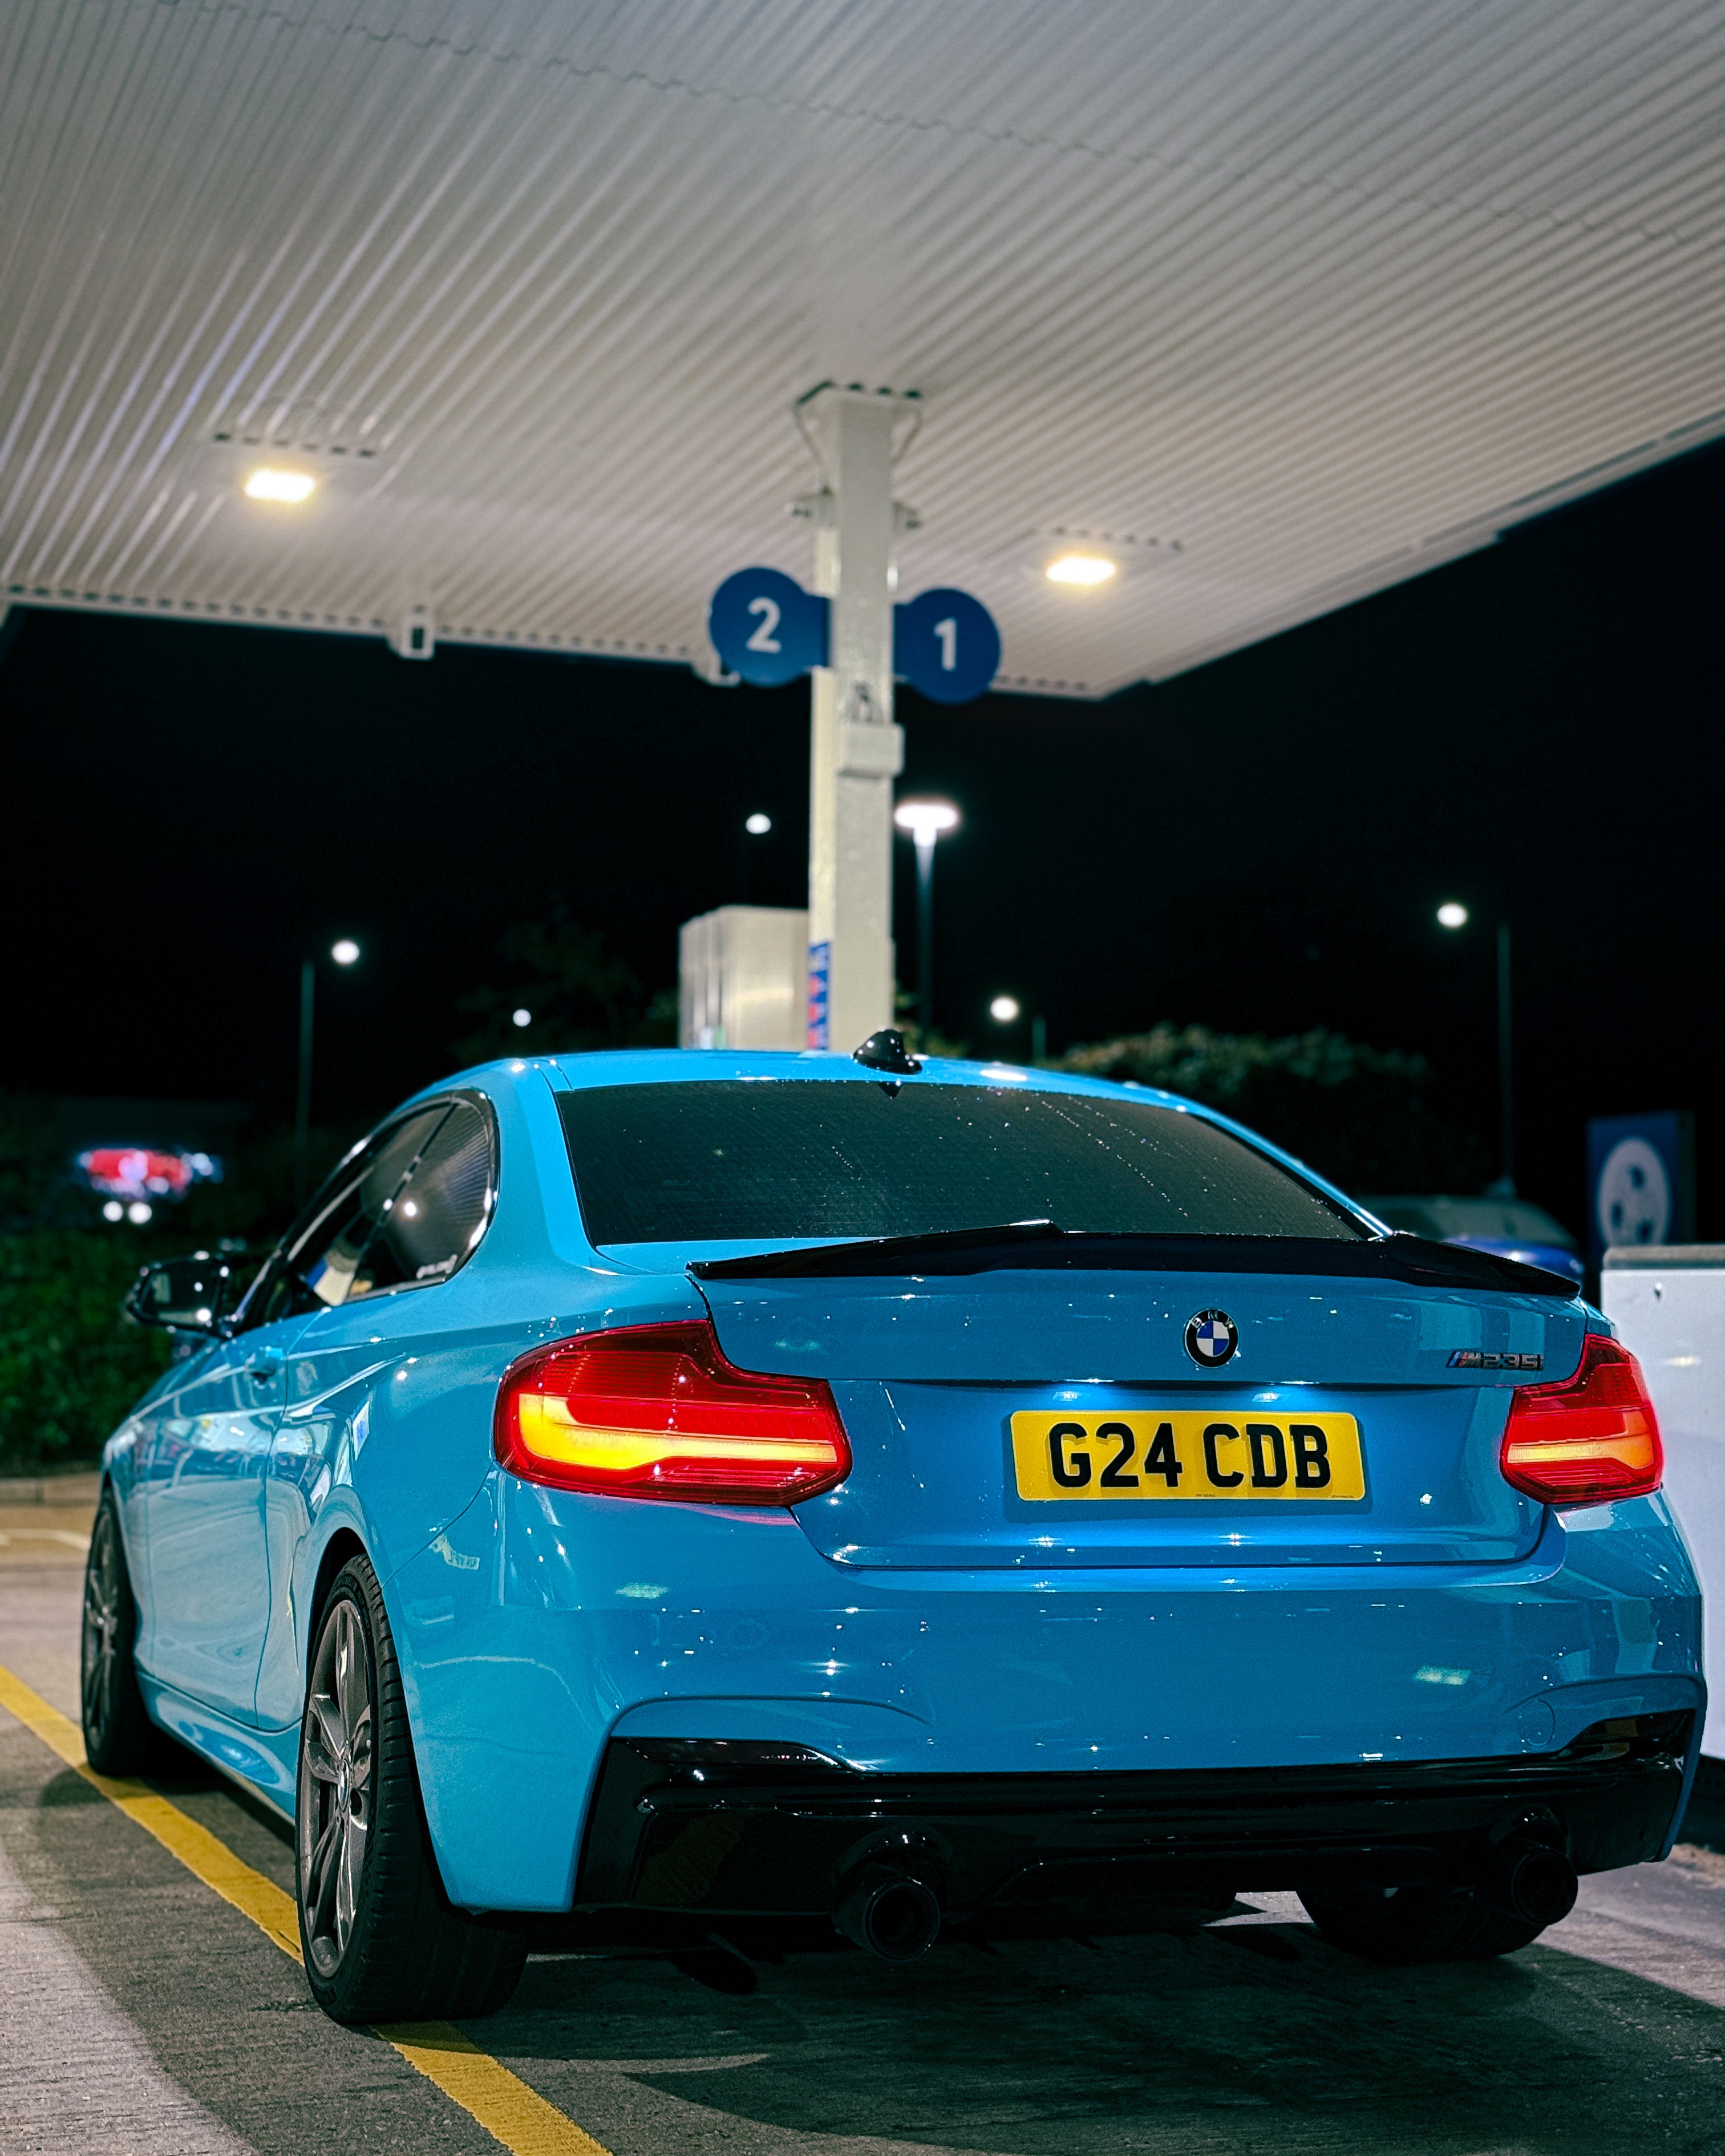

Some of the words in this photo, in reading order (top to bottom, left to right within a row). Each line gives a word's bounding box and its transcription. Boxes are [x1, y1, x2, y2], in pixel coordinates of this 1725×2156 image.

[746, 597, 781, 654] 2
[934, 617, 957, 672] 1
[1191, 1311, 1234, 1329] BMW
[1048, 1422, 1183, 1488] G24
[1202, 1423, 1331, 1489] CDB
